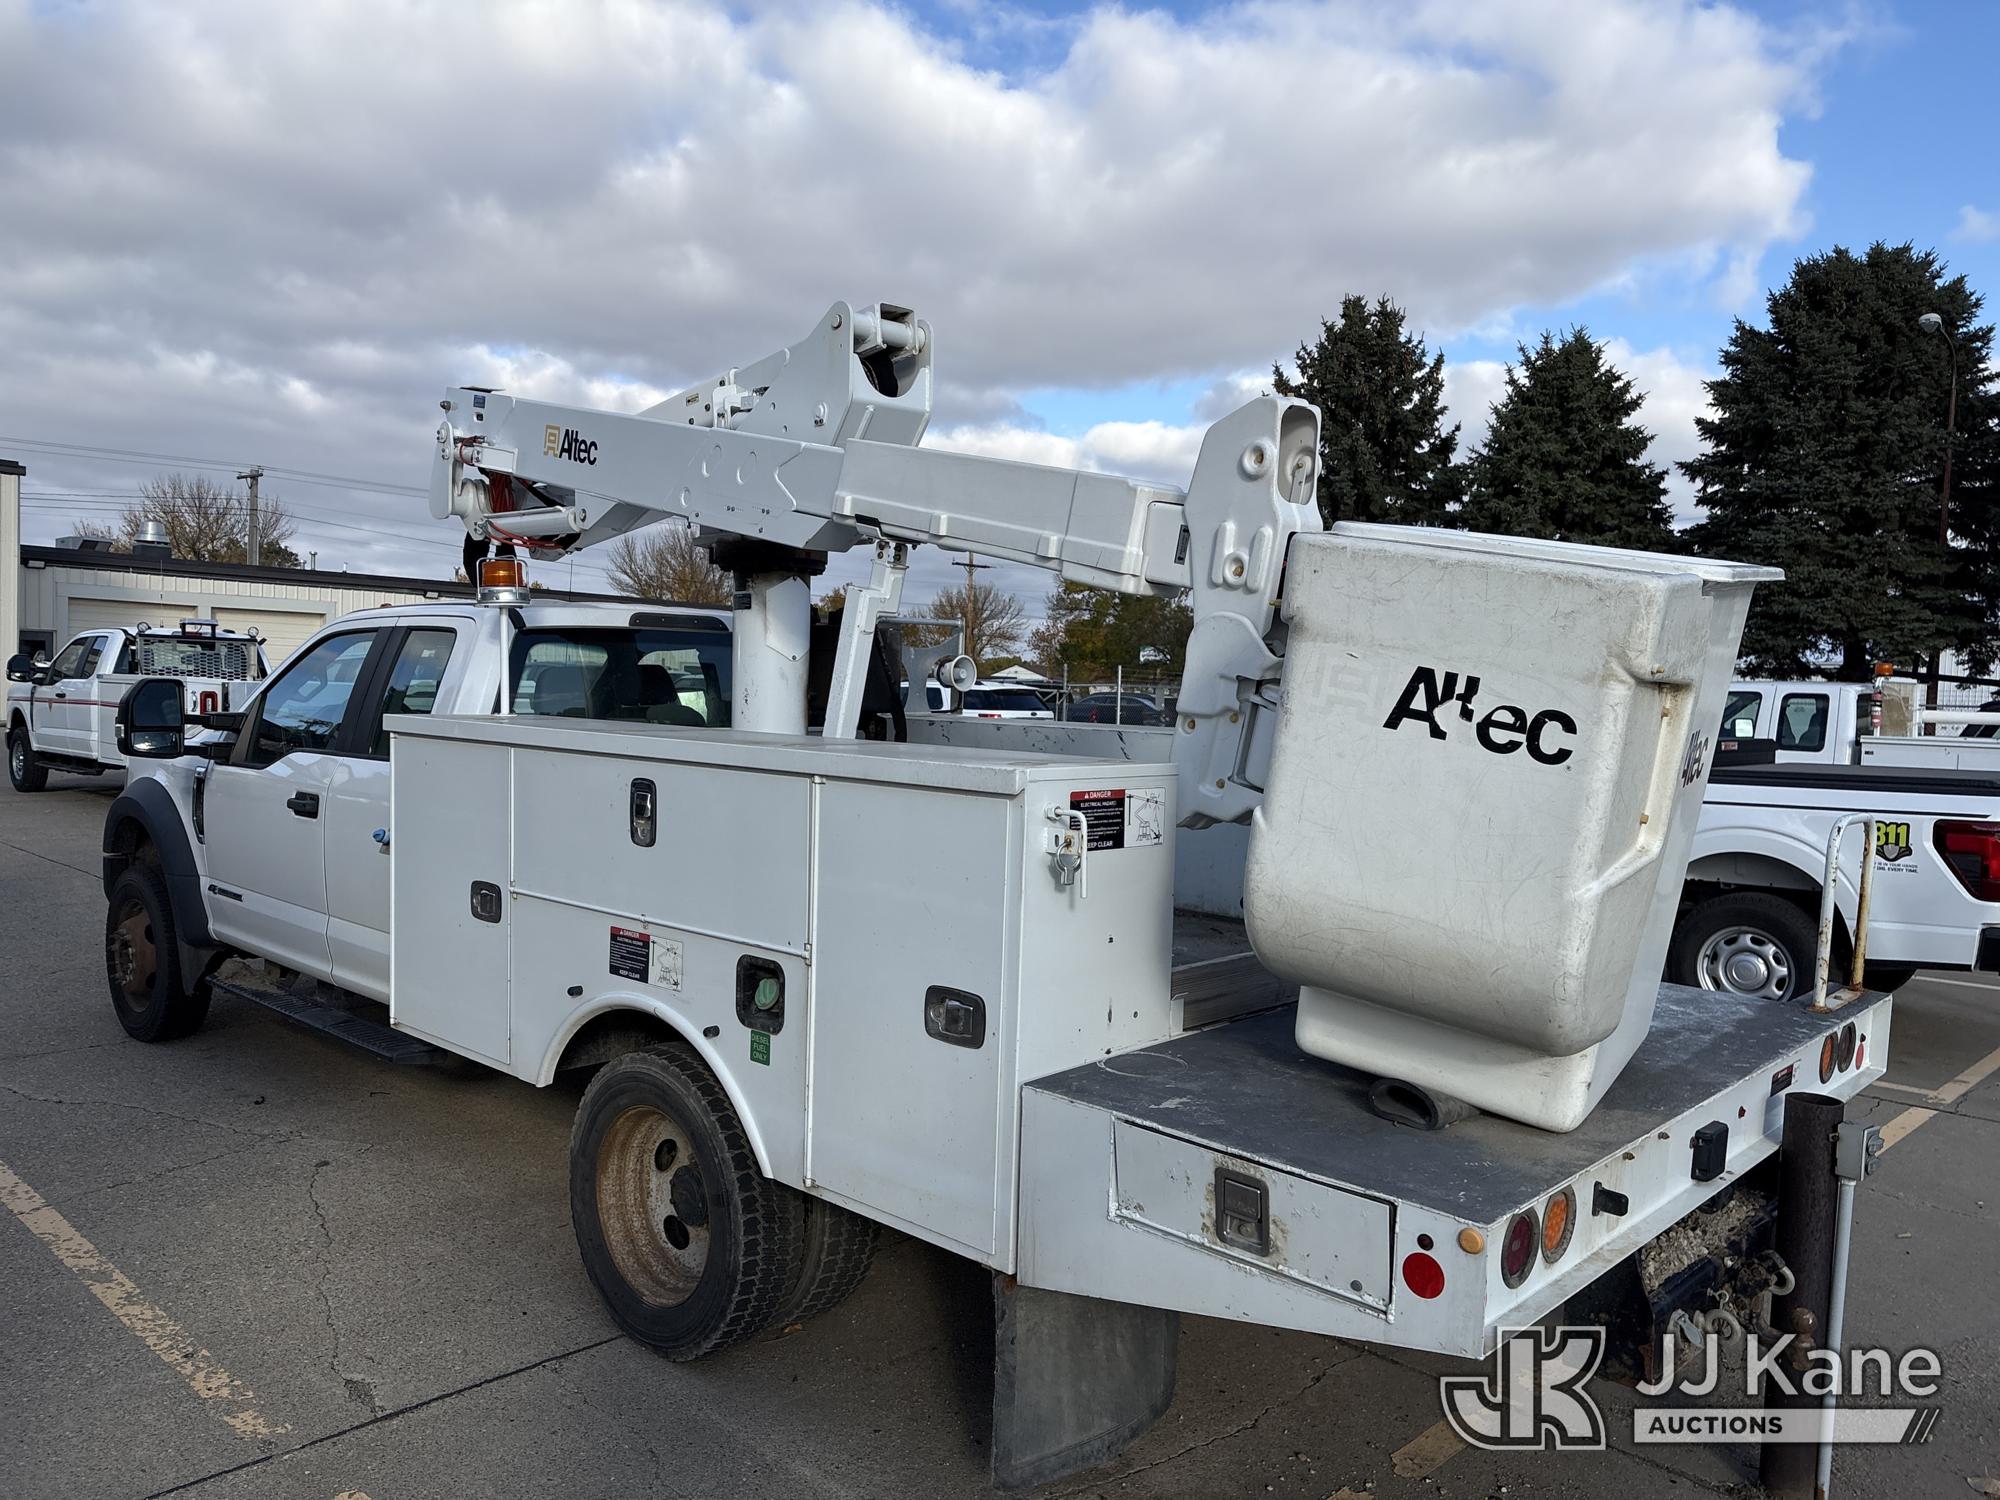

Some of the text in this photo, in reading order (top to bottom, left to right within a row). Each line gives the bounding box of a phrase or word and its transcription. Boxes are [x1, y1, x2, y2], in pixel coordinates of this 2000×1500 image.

[559, 429, 598, 466] Altec
[1090, 791, 1111, 799] DANGER
[752, 1034, 769, 1045] DIESEL
[753, 1042, 767, 1054] FUEL
[753, 1051, 767, 1061] ONLY
